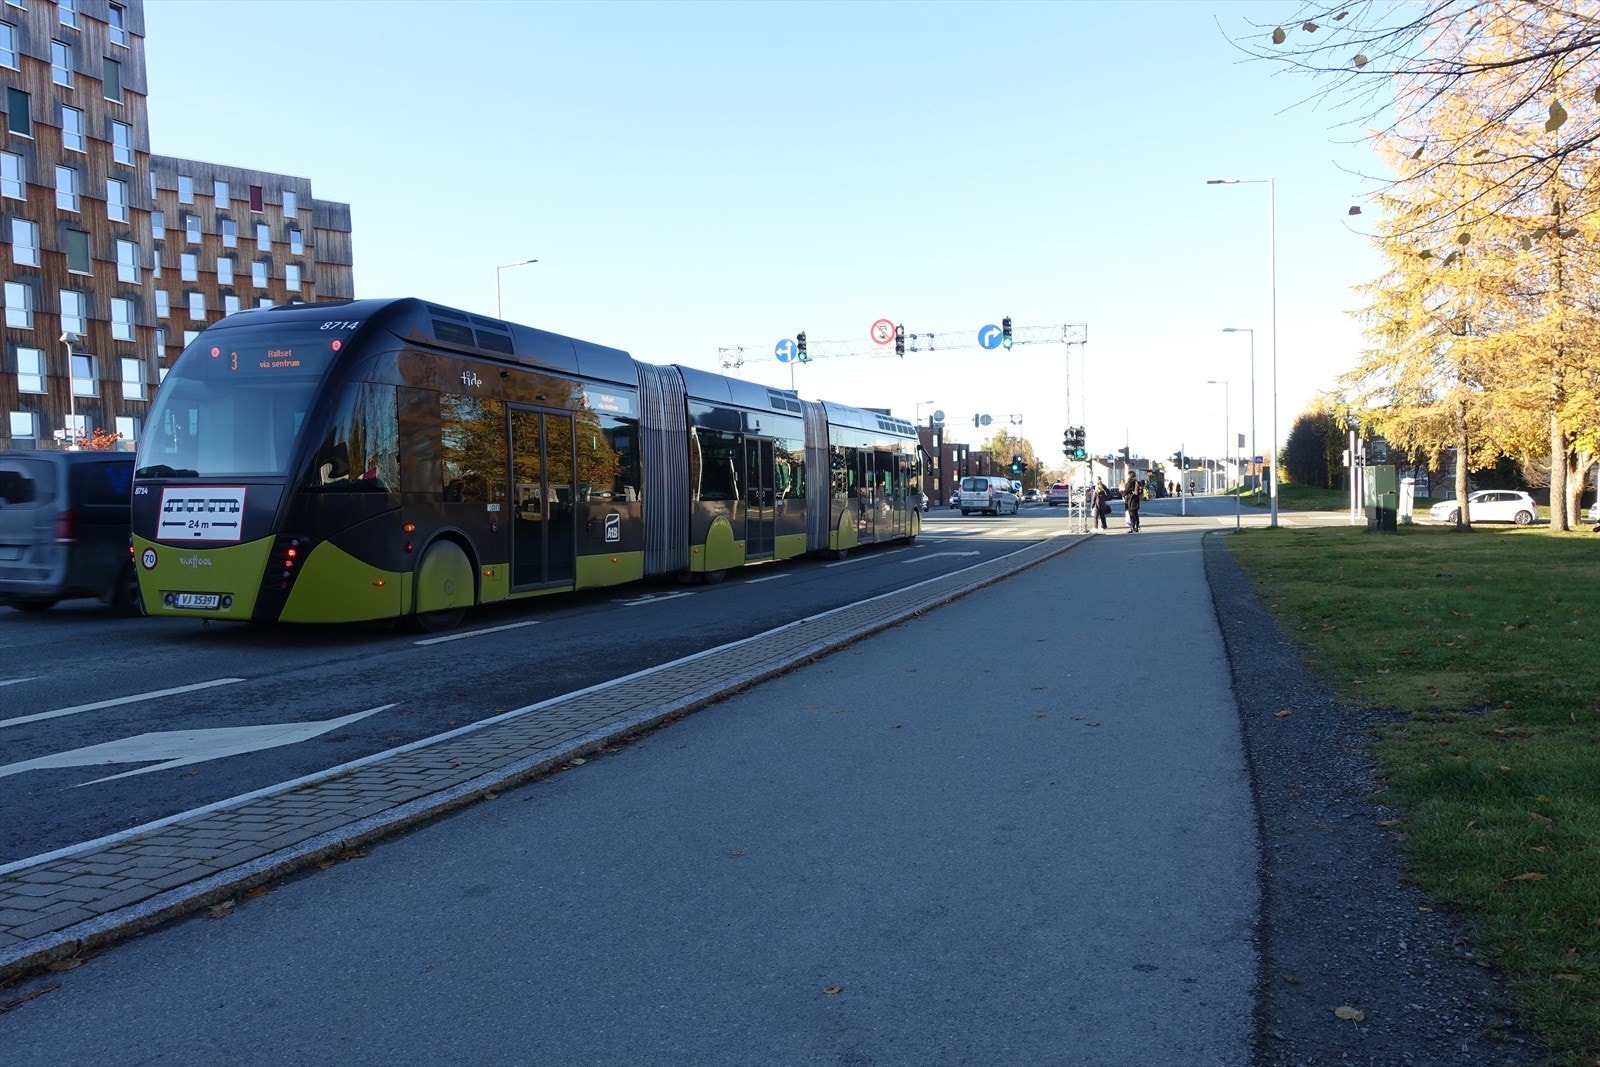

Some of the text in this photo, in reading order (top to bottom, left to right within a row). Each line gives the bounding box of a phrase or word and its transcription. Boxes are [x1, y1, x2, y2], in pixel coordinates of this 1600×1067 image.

[320, 321, 359, 330] 8714
[268, 350, 292, 358] Hallset
[231, 352, 238, 370] 3
[271, 360, 300, 368] sentrum
[460, 370, 483, 388] tide
[134, 487, 148, 495] 8714
[188, 520, 209, 529] 24 m
[144, 554, 155, 564] 70
[182, 595, 217, 606] VJ 15391
